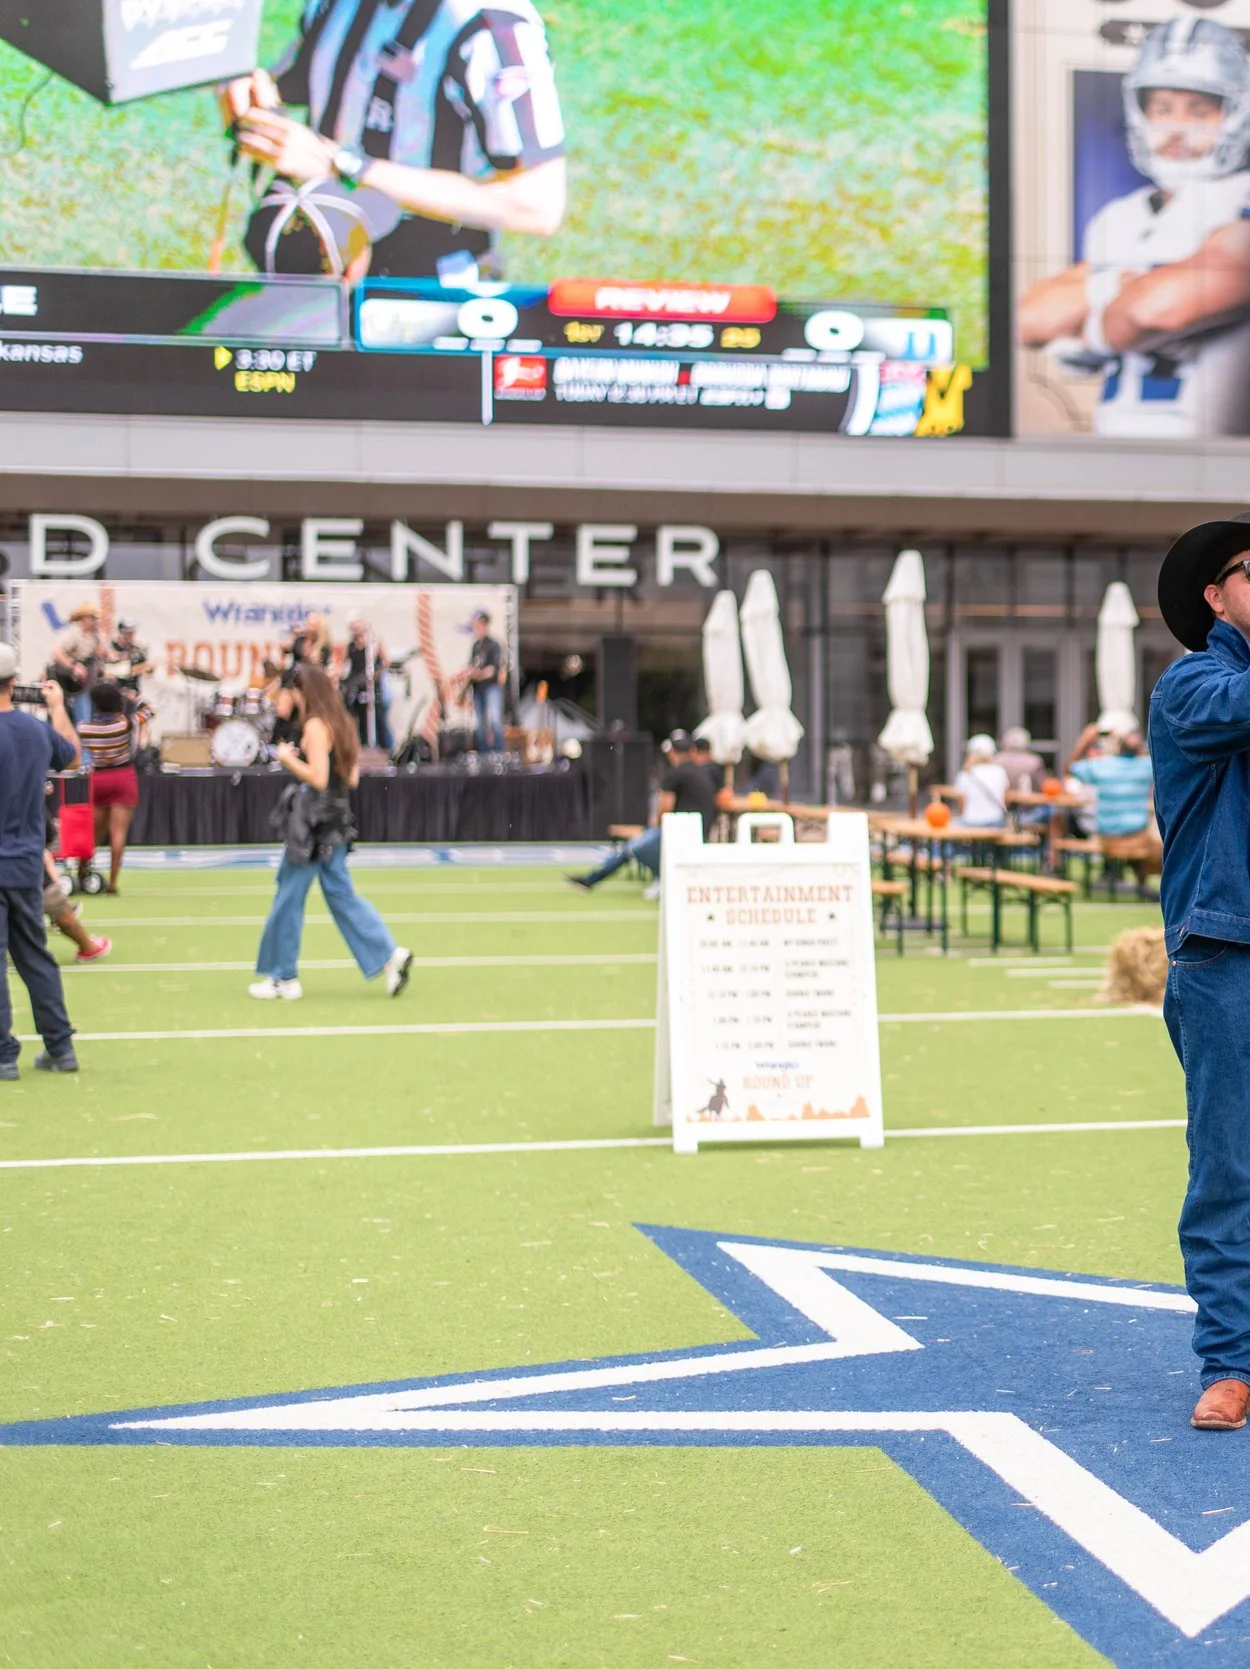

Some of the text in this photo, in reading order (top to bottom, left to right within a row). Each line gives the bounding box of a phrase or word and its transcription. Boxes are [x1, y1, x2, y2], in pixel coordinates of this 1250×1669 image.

[594, 286, 732, 313] REVIEW
[234, 371, 296, 393] ESPN
[196, 516, 721, 588] CENTER
[687, 884, 854, 905] ENTERTAINMENT
[726, 908, 817, 926] SCHEDULE
[743, 1074, 814, 1090] ROUND UP
